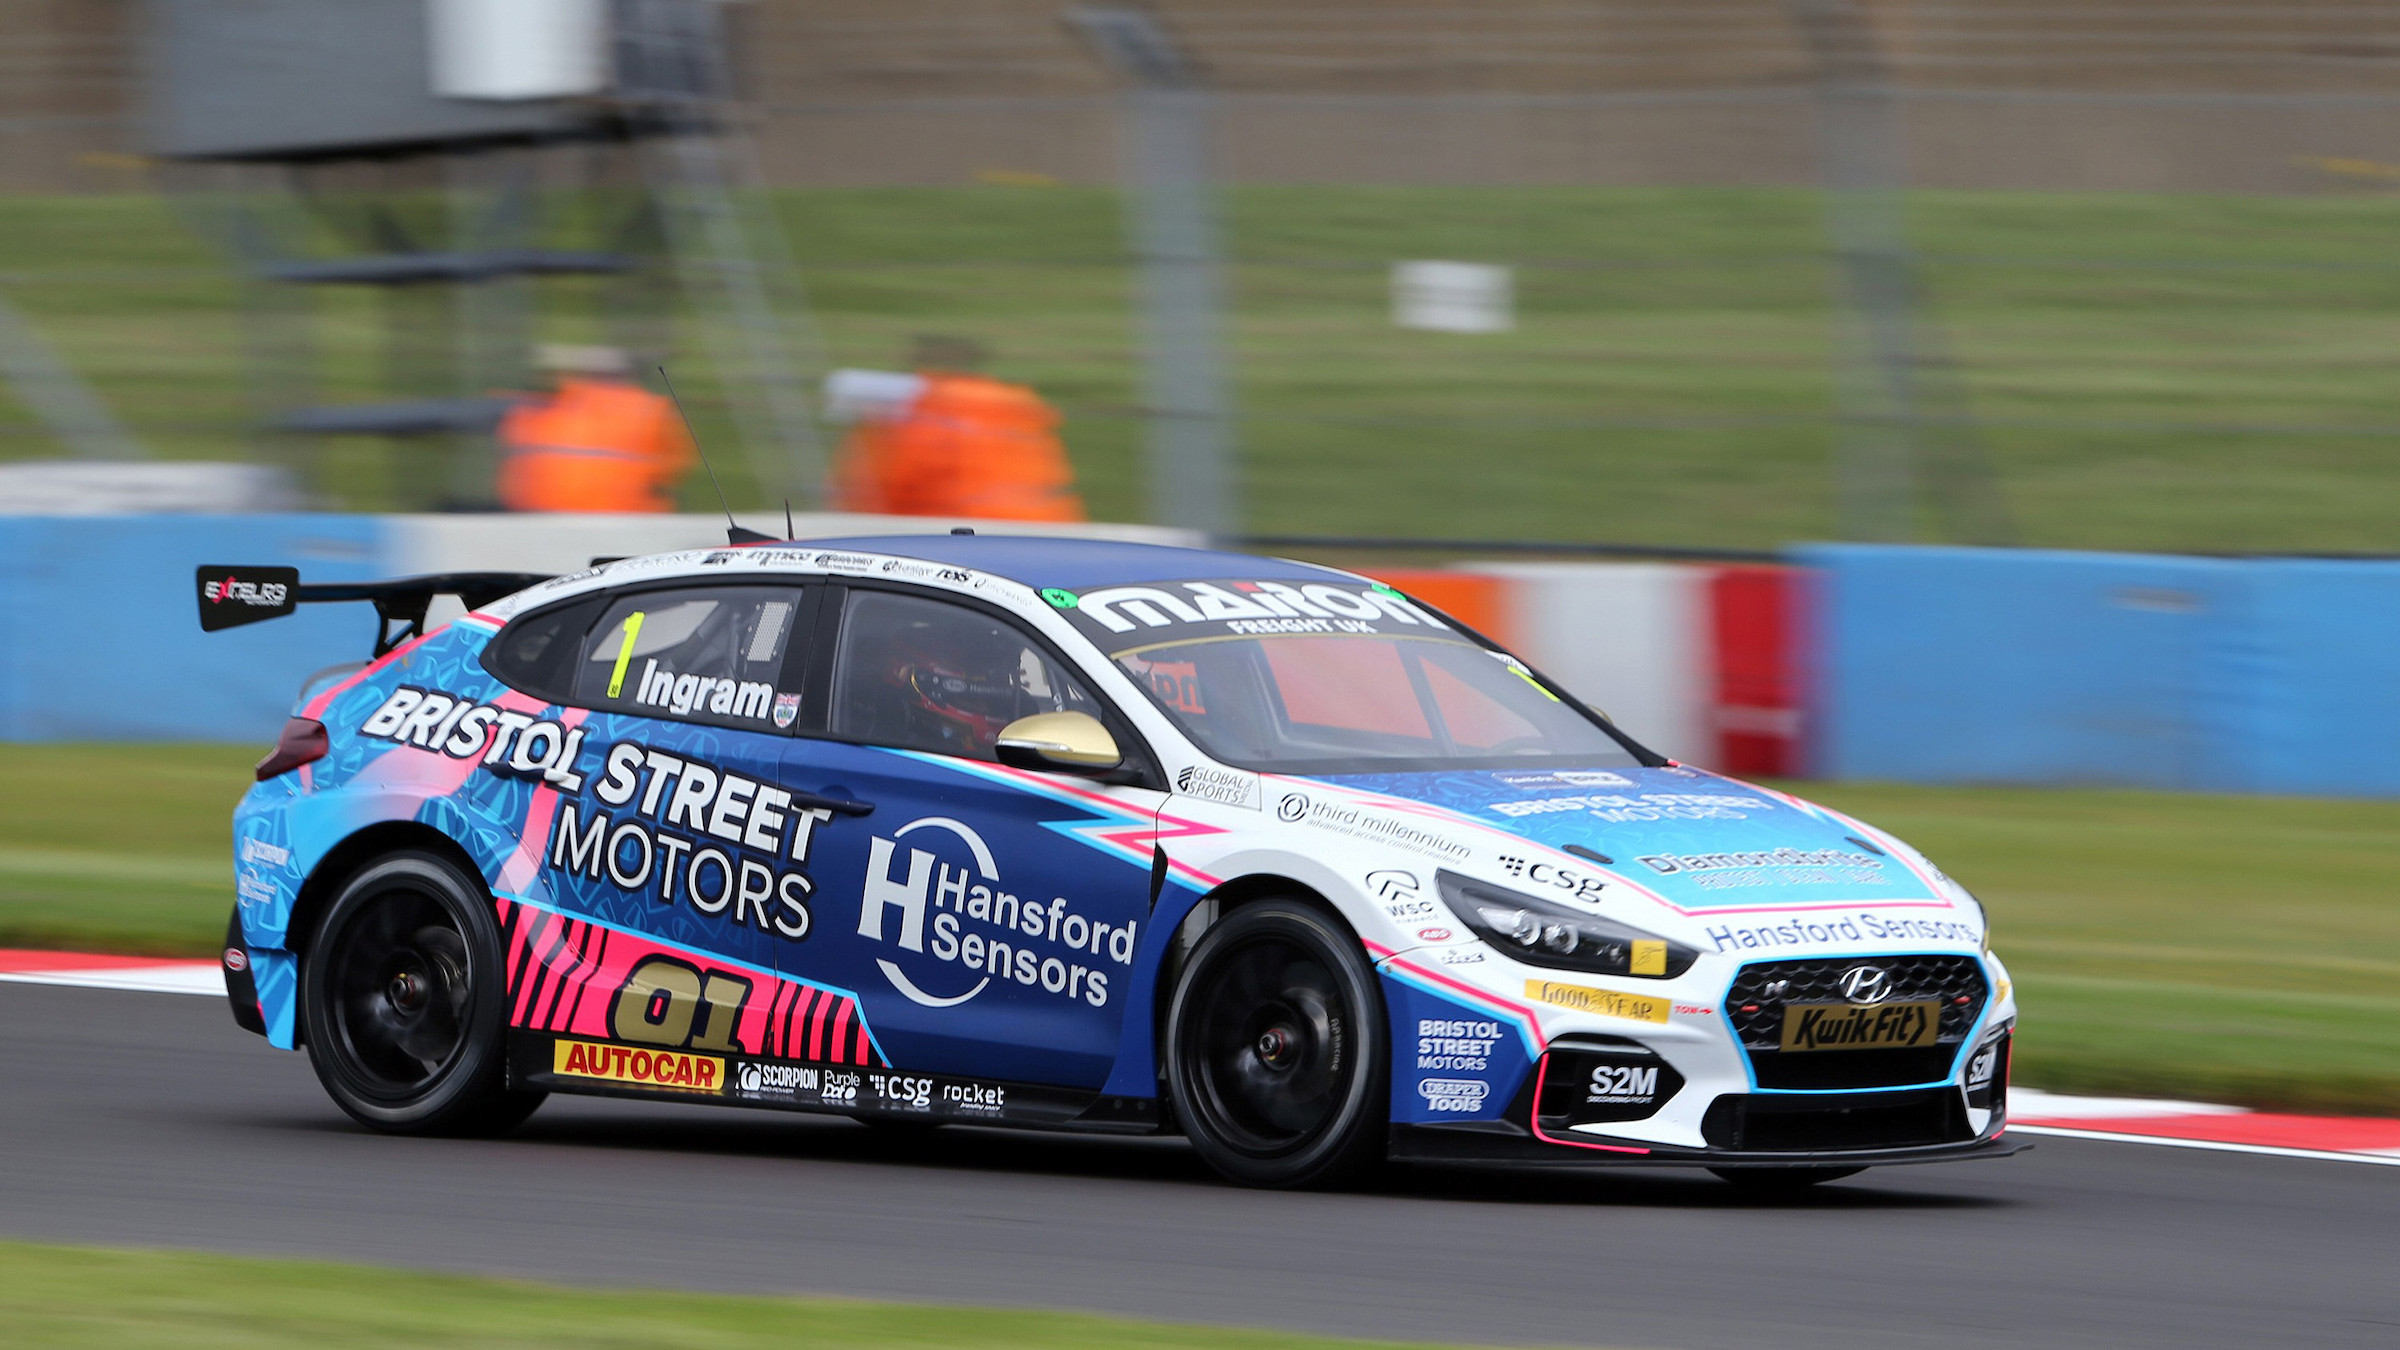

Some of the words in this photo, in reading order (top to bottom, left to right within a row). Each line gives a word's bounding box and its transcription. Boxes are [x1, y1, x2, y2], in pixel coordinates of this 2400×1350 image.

[1226, 619, 1333, 635] FREIGHT
[1335, 619, 1378, 634] UK
[606, 611, 646, 699] 1
[636, 657, 773, 720] Ingram
[360, 686, 587, 791] BRISTOL
[596, 743, 833, 859] STREET
[1193, 766, 1244, 788] GLOBAL
[1187, 781, 1240, 804] SPORTS
[1313, 802, 1359, 824] third
[1361, 816, 1472, 859] millennium
[553, 805, 812, 939] MOTORS
[1529, 863, 1611, 904] csg
[857, 836, 937, 953] H
[1386, 901, 1434, 917] WSC
[934, 861, 1137, 965] Hansford
[1704, 915, 1863, 953] Hansford
[1859, 913, 1980, 944] Sensors
[931, 915, 1109, 1008] Sensors
[611, 958, 749, 1053] 01
[1674, 1005, 1700, 1015] TOW
[1418, 1019, 1504, 1039] BRISTOL
[1418, 1038, 1495, 1056] STREET
[564, 1043, 717, 1088] AUTOCAR
[762, 1064, 818, 1090] SCORPION
[824, 1069, 860, 1087] Purple
[1417, 1055, 1487, 1071] MOTORS
[888, 1076, 933, 1107] csg
[943, 1083, 1005, 1105] rocket
[1589, 1065, 1659, 1095] S2M
[1427, 1095, 1483, 1113] Tools
